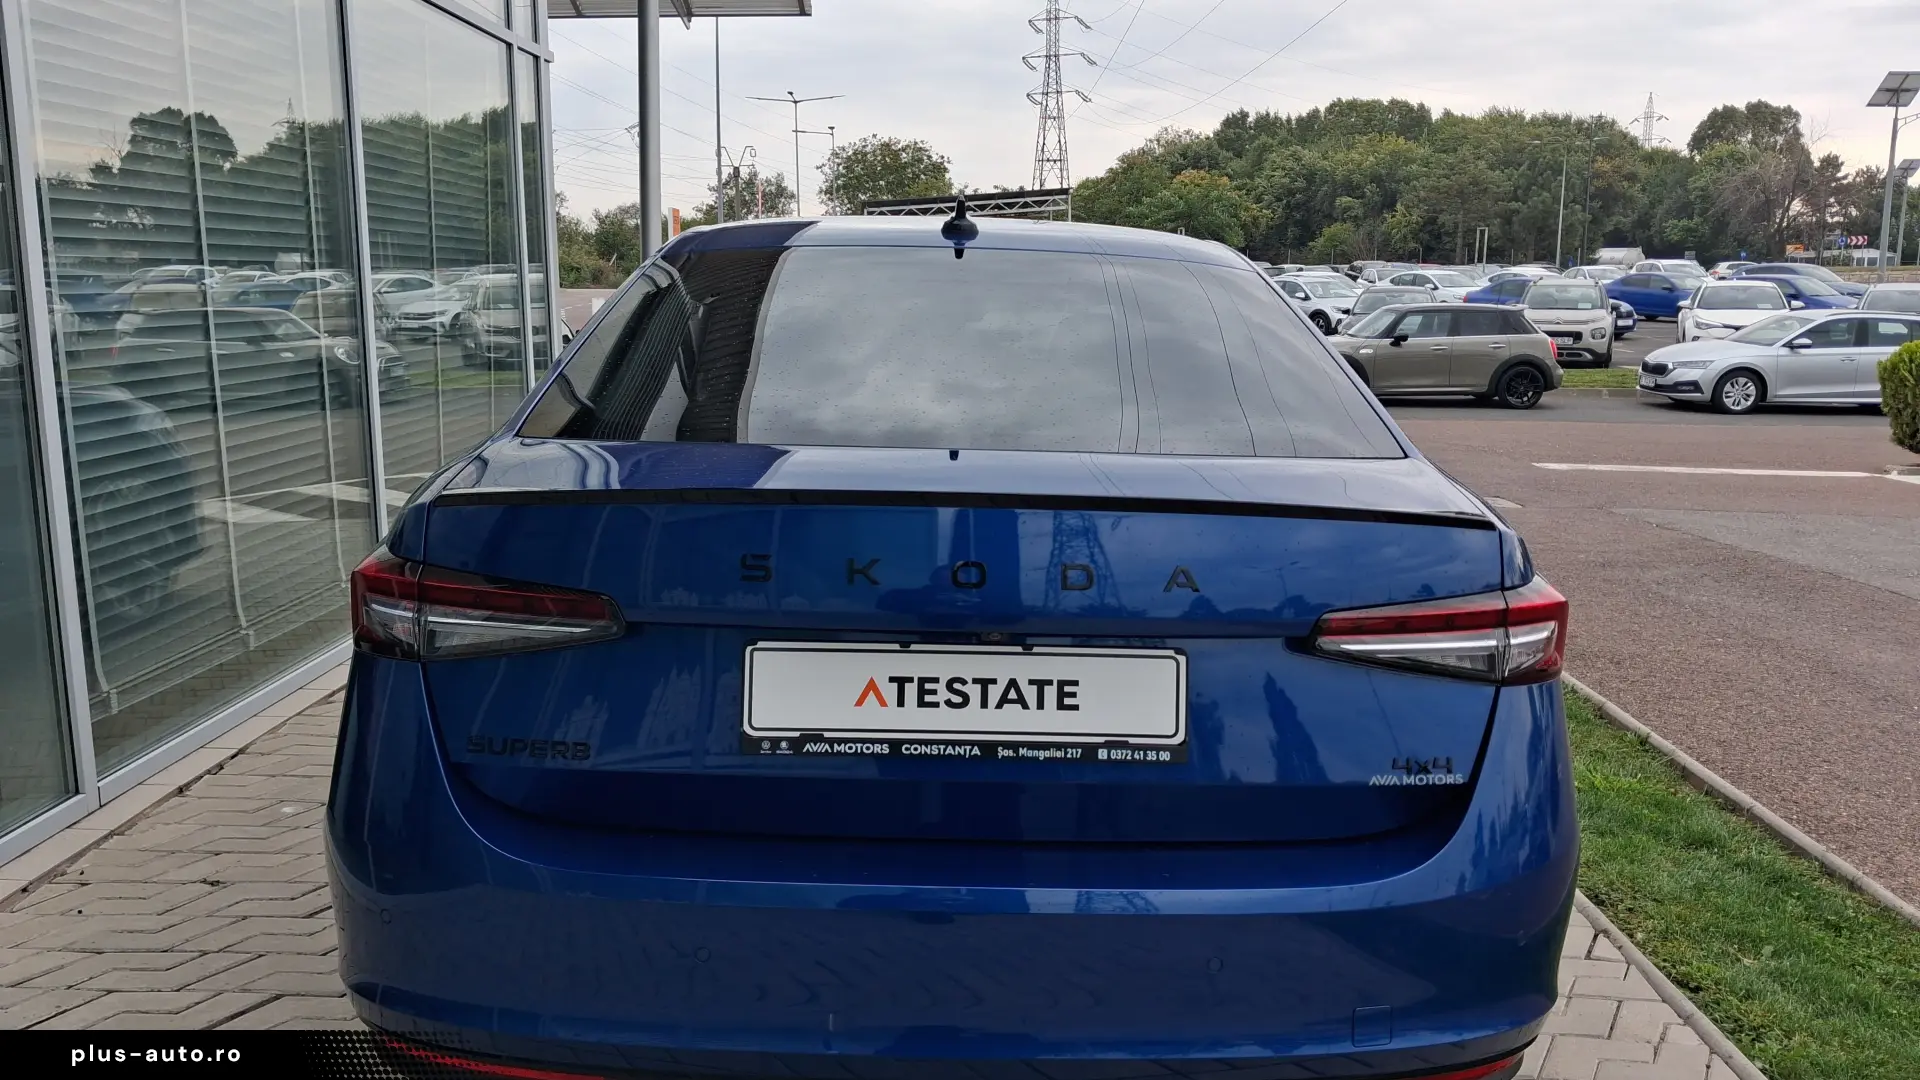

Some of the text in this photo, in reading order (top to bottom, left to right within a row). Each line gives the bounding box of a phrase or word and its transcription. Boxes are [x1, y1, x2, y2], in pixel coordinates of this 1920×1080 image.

[853, 675, 1080, 711] ATESTATE
[466, 735, 591, 761] SUPERB
[833, 743, 890, 754] MOTORS
[1018, 747, 1064, 760] Mangaliei
[1066, 748, 1082, 758] 217
[1110, 750, 1132, 760] 0372
[1133, 750, 1143, 760] 41
[1146, 750, 1157, 761] 35
[1158, 750, 1171, 761] 00
[1392, 756, 1453, 775] 4x4
[1402, 773, 1464, 786] MOTORS
